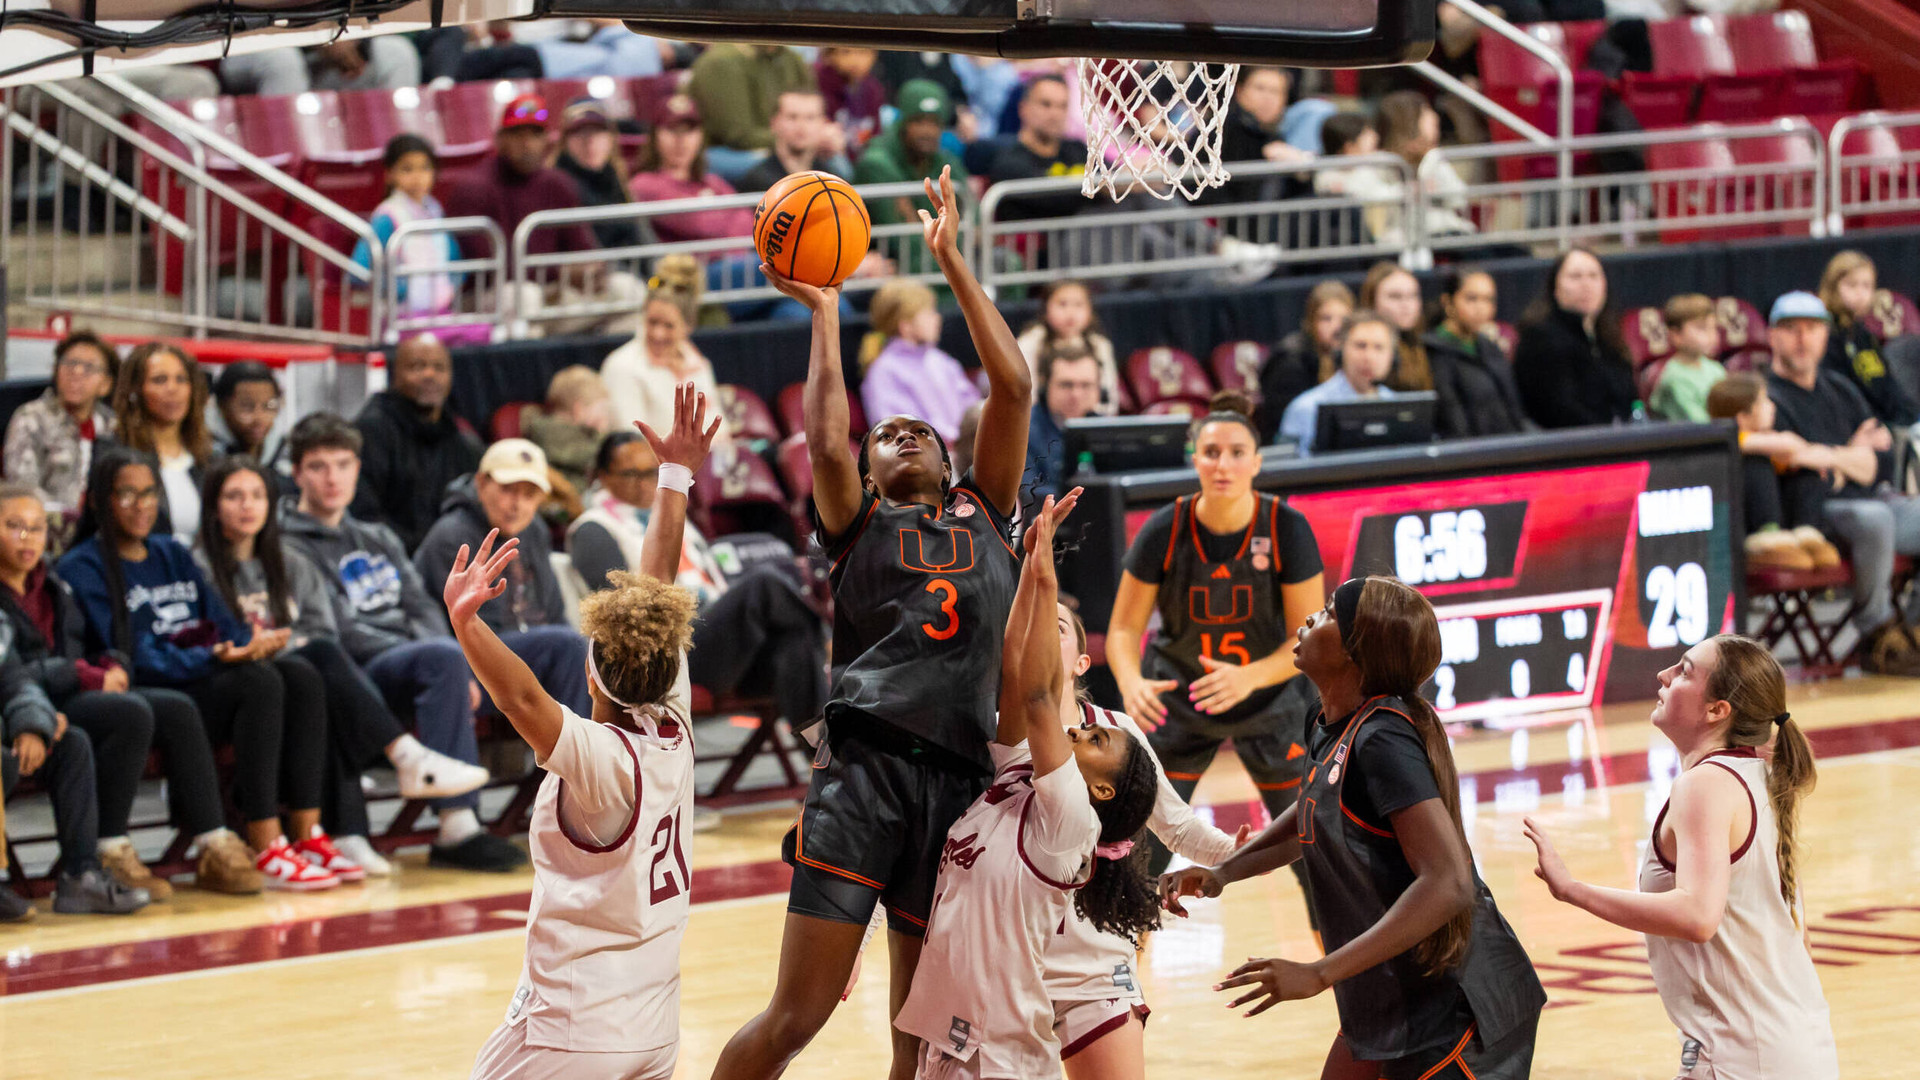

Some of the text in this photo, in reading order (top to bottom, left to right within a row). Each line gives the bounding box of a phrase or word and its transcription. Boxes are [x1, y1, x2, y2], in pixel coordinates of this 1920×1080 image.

[764, 211, 796, 268] Wilso
[899, 528, 974, 573] U
[1394, 509, 1487, 584] 6:56
[922, 578, 960, 641] 3
[1189, 585, 1253, 625] U
[1646, 562, 1709, 649] 29
[1200, 631, 1251, 674] 15
[1434, 665, 1457, 709] 2
[650, 805, 690, 906] 21
